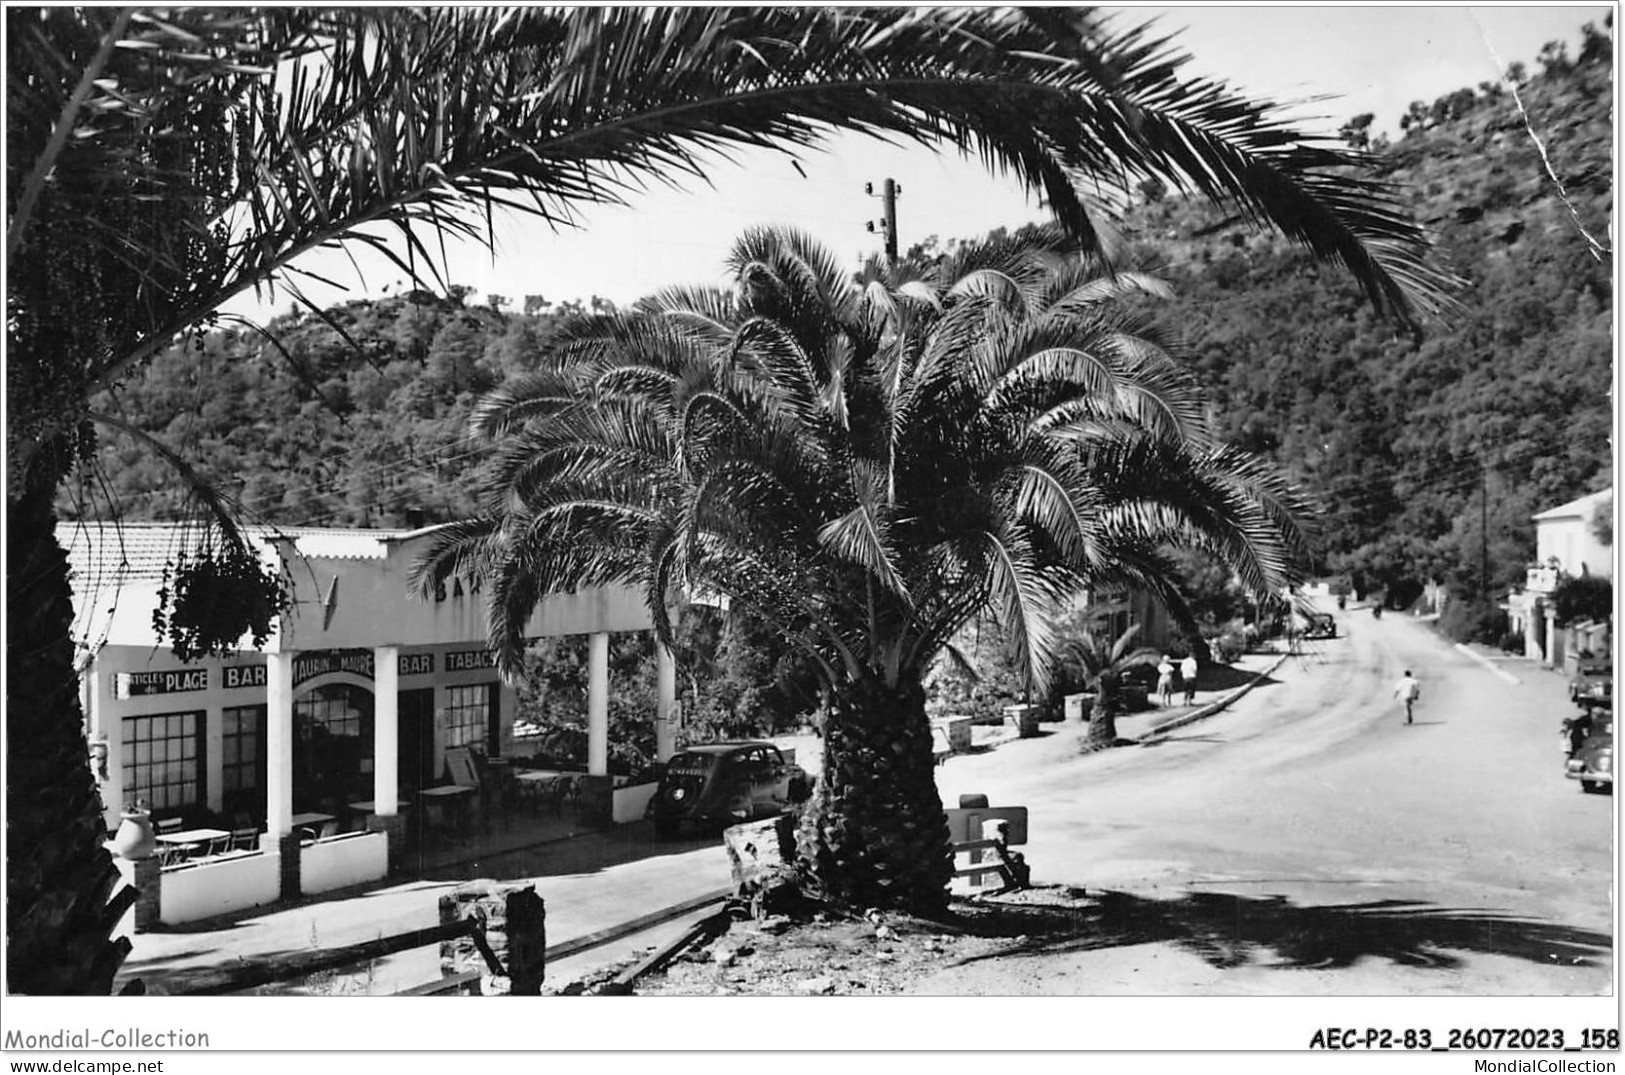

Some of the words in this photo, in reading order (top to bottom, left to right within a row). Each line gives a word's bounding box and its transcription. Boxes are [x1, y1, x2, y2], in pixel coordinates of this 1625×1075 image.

[400, 655, 431, 673] BAR
[129, 673, 164, 685] TICLES
[166, 671, 208, 691] PLAGE
[227, 666, 266, 687] BAR
